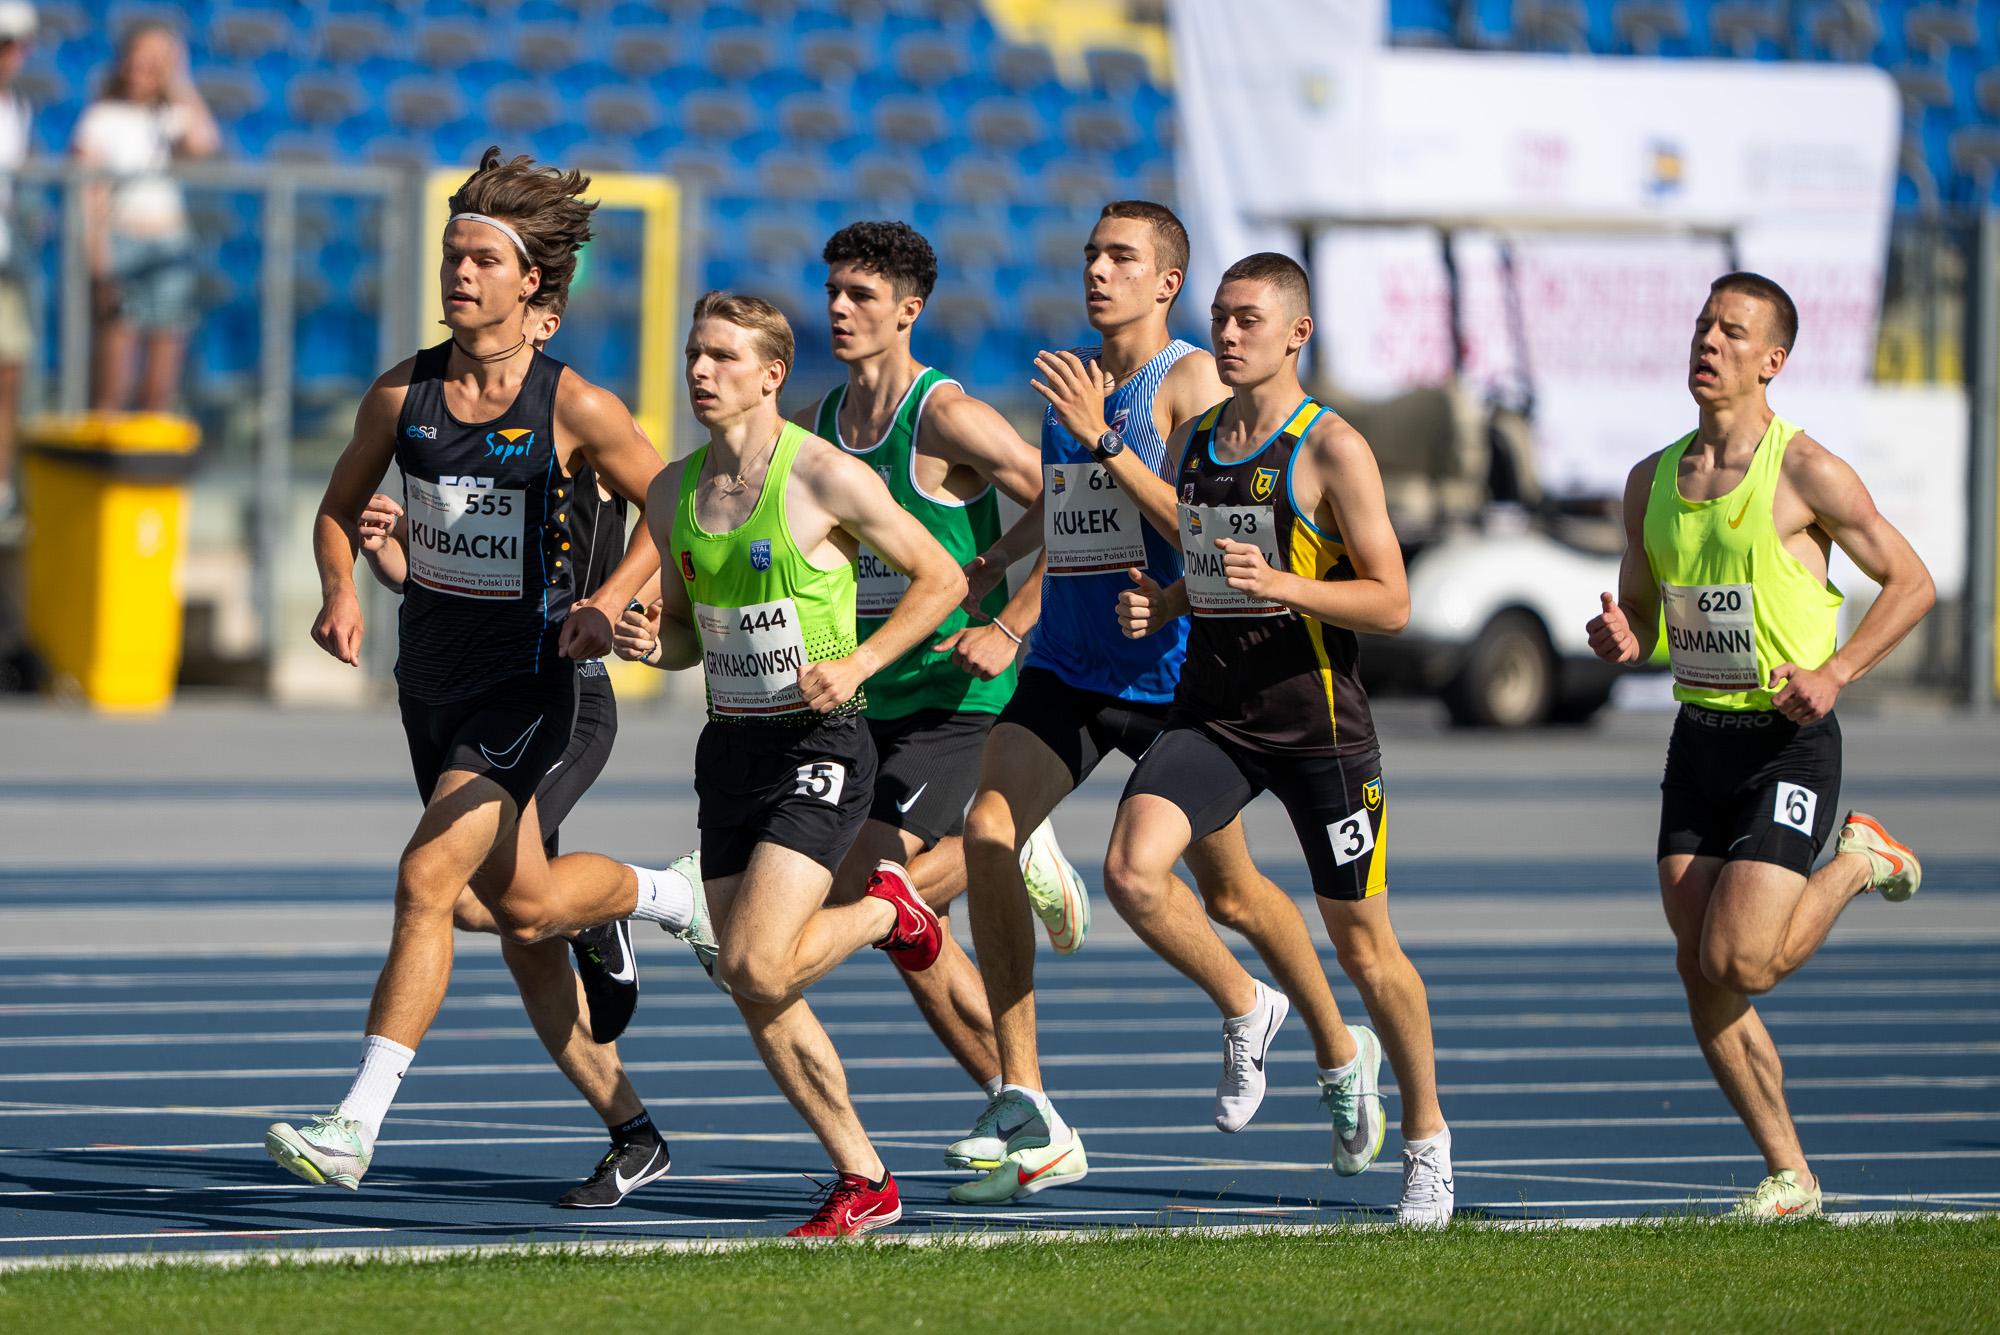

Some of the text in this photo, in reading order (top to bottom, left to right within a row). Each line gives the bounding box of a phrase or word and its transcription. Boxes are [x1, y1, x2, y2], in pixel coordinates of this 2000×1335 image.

[484, 432, 535, 465] Sopot
[465, 493, 513, 517] 555
[1053, 508, 1121, 536] KUŁEK
[1229, 513, 1257, 535] 93
[411, 518, 517, 560] KUBACKI
[751, 545, 769, 554] STAL
[857, 555, 904, 578] ERCZ
[1065, 553, 1102, 563] Mistrzostwa
[1104, 552, 1127, 561] Polski
[1128, 549, 1144, 558] U18
[419, 565, 432, 577] PZLA
[432, 571, 475, 586] Mistrzostwa
[478, 578, 502, 587] Polski
[504, 579, 521, 587] U18
[857, 596, 900, 606] rzostwa Polsk
[1205, 596, 1245, 605] Mistrzostwa
[1698, 590, 1741, 613] 620
[740, 607, 787, 635] 444
[1666, 622, 1751, 653] NEUMANN
[706, 645, 802, 678] GRYKAŁOWSKI
[1720, 672, 1741, 680] Polski
[732, 695, 770, 704] Mistrzostwa
[771, 691, 796, 703] Polski
[1684, 704, 1773, 729] NIKE PRO
[805, 764, 833, 798] 5
[1786, 789, 1808, 826] 6
[1340, 819, 1365, 856] 3
[622, 1114, 649, 1132] adid
